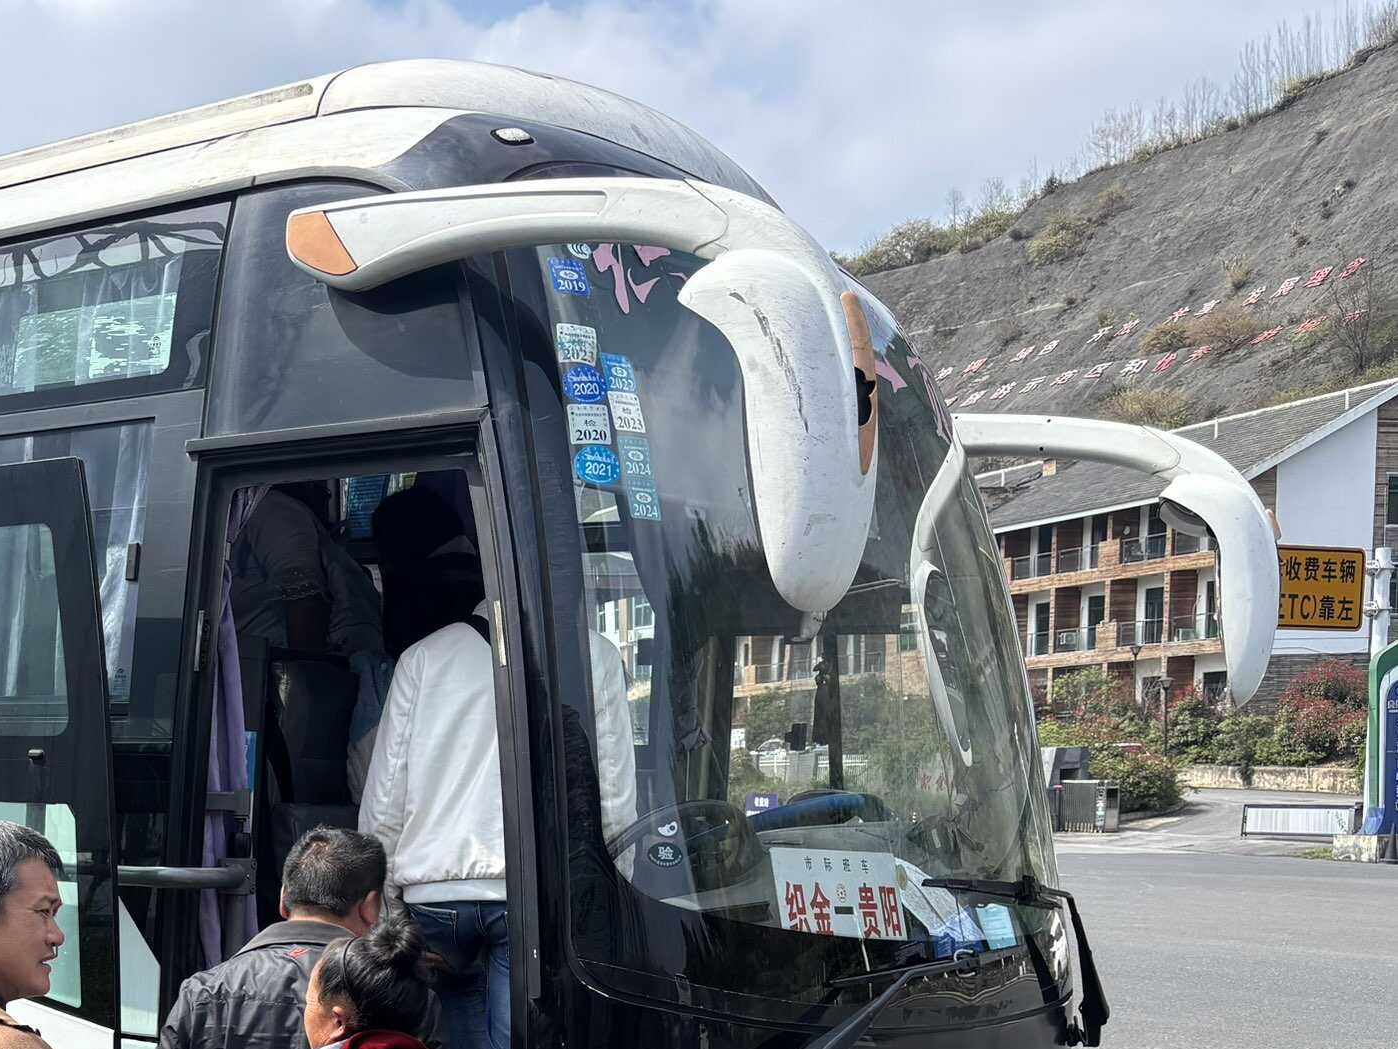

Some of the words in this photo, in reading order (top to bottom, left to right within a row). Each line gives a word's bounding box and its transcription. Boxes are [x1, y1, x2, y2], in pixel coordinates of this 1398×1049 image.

[558, 280, 586, 291] 2019
[573, 383, 601, 396] 2020
[616, 416, 644, 431] 2023
[575, 429, 608, 442] 2020
[585, 462, 612, 477] 2021
[625, 462, 652, 476] 2024
[633, 503, 659, 518] 2024
[1280, 556, 1357, 584] 收费车辆
